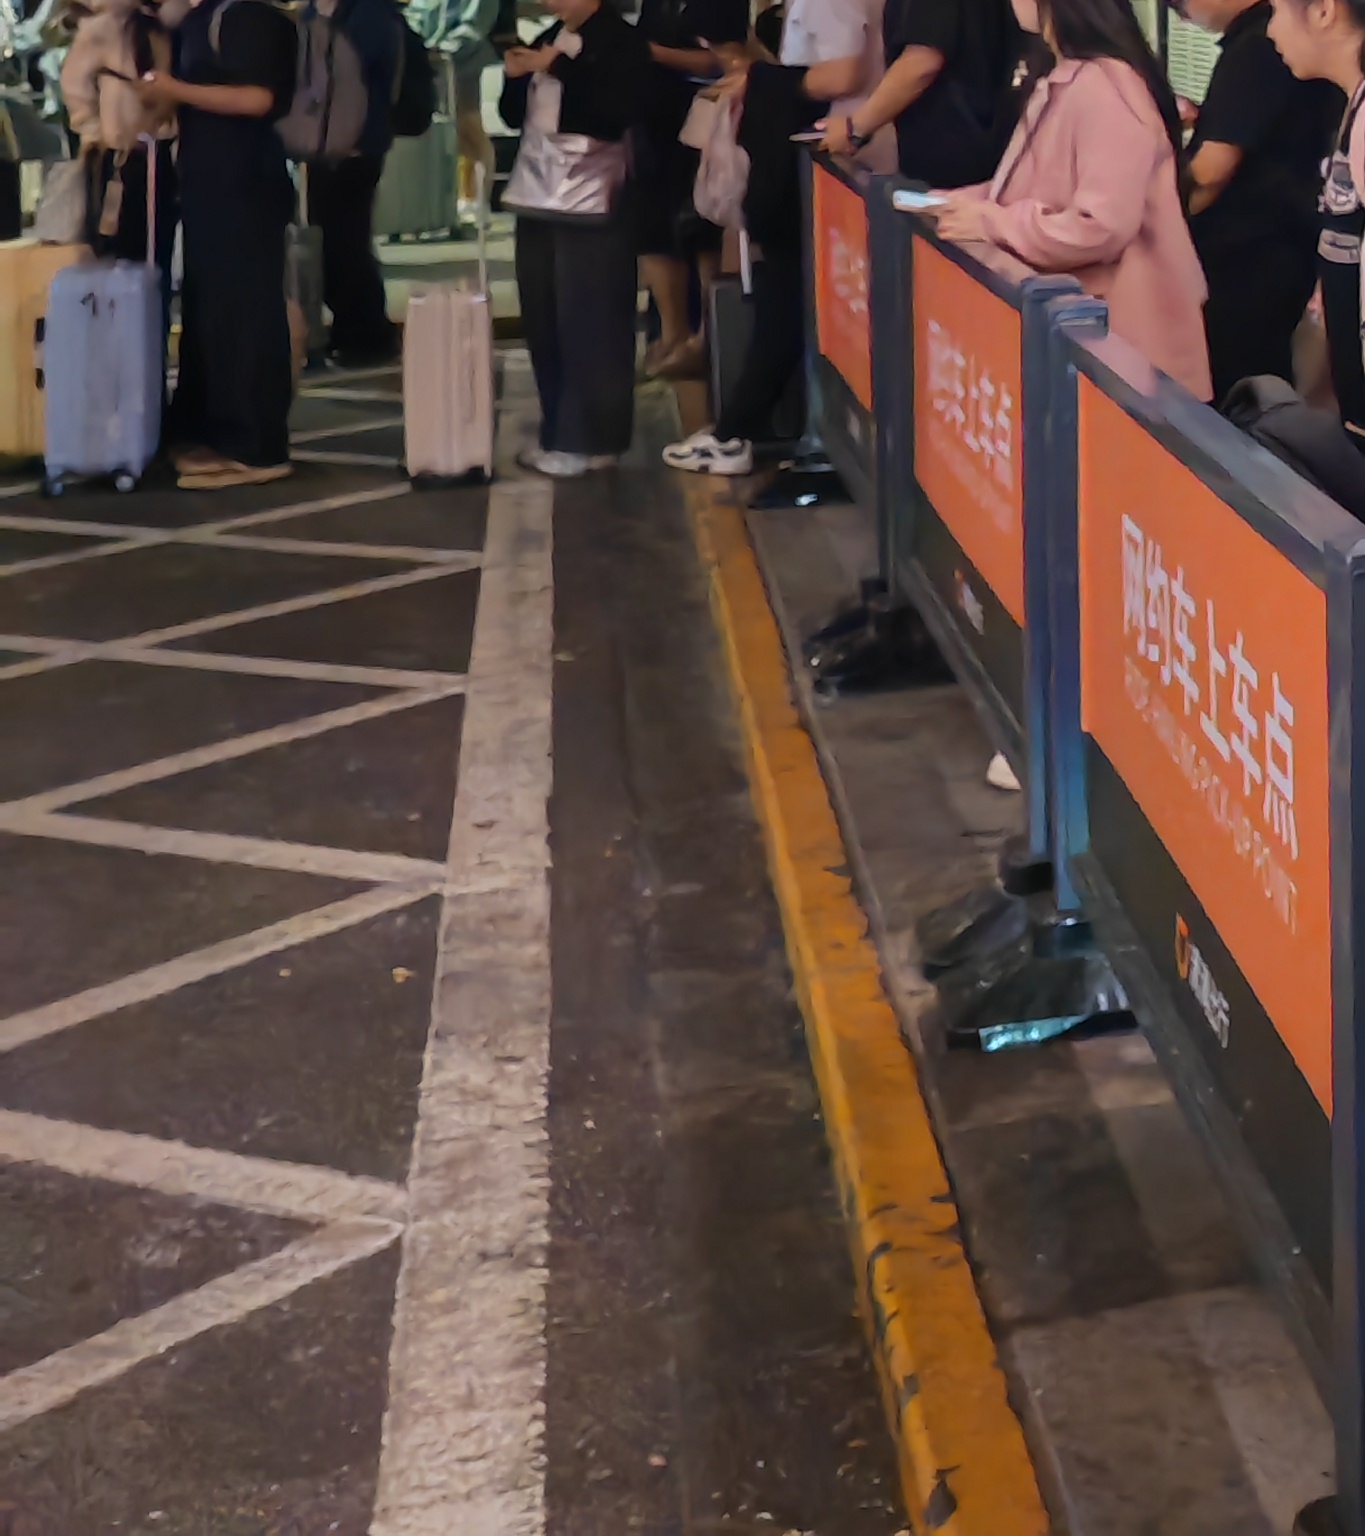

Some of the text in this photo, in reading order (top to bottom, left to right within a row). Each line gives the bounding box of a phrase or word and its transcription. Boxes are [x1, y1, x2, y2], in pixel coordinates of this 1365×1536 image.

[1121, 512, 1299, 861] 网约车上车点
